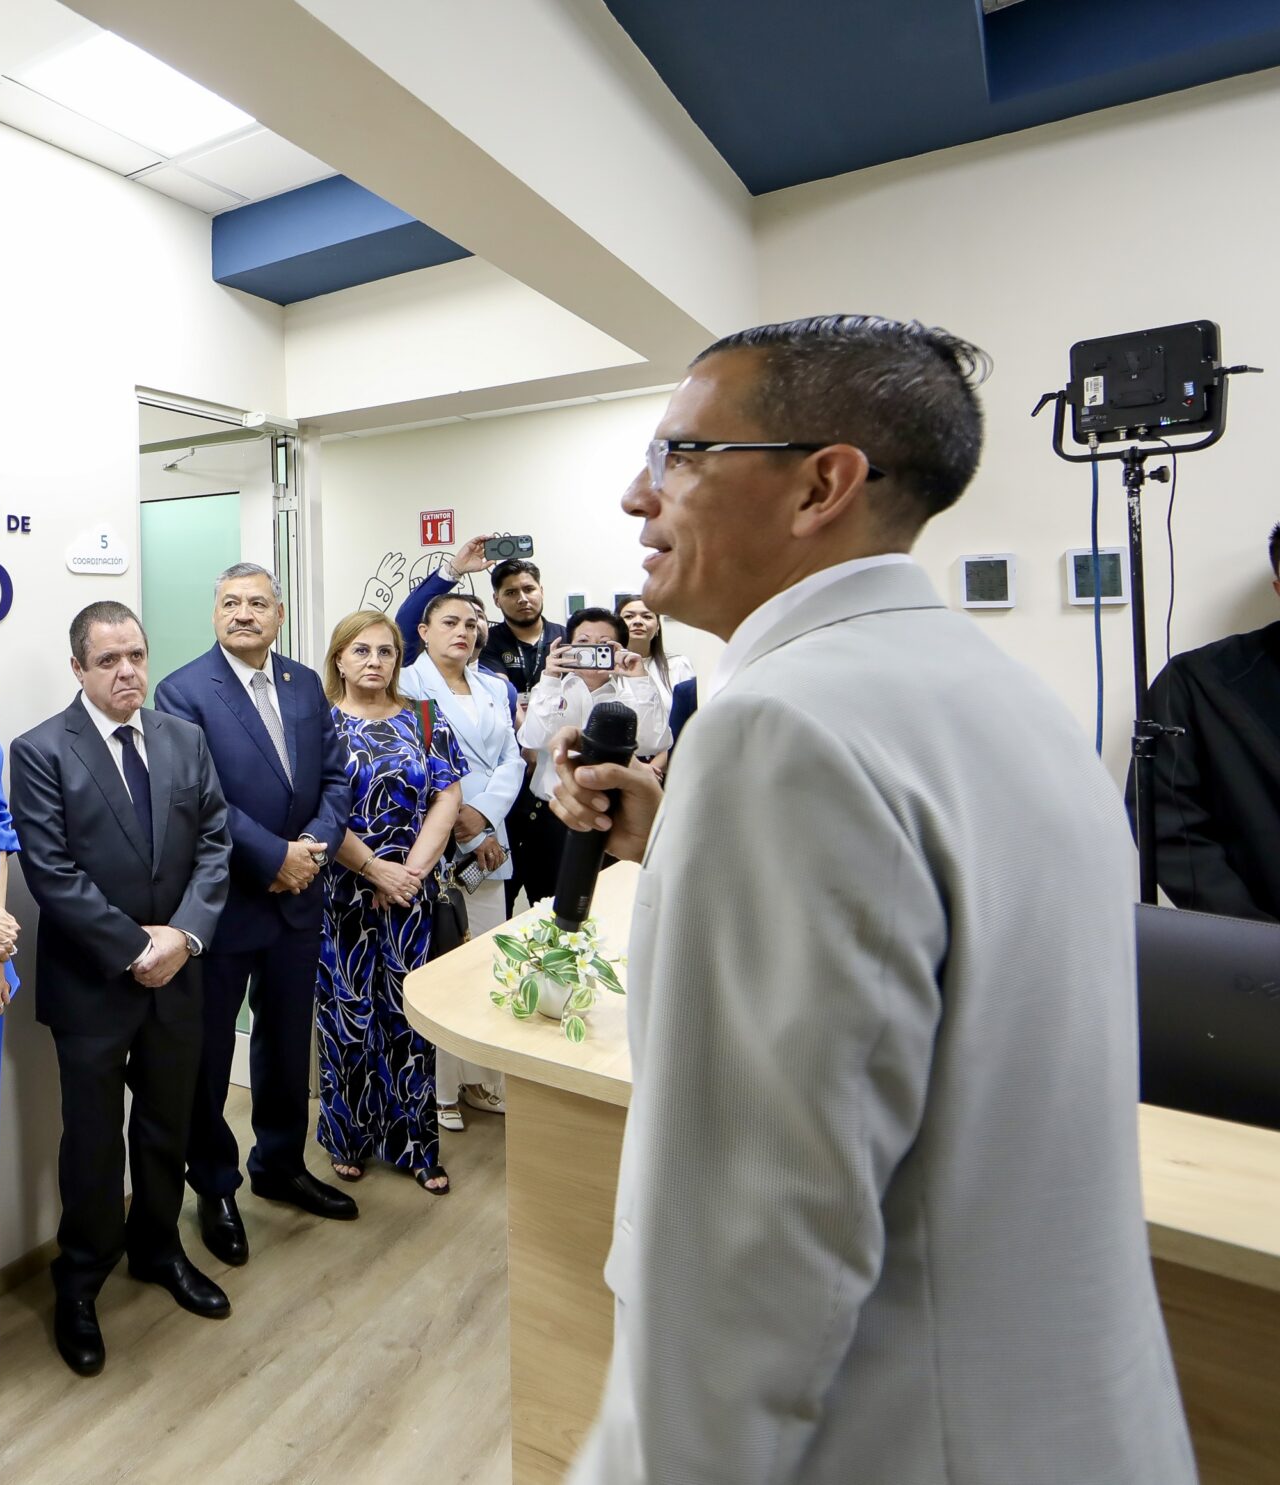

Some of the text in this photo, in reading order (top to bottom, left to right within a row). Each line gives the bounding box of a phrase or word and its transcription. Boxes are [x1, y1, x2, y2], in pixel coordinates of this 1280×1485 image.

[7, 514, 32, 533] DE
[422, 512, 451, 521] EXTINTOR
[100, 534, 109, 549] 5
